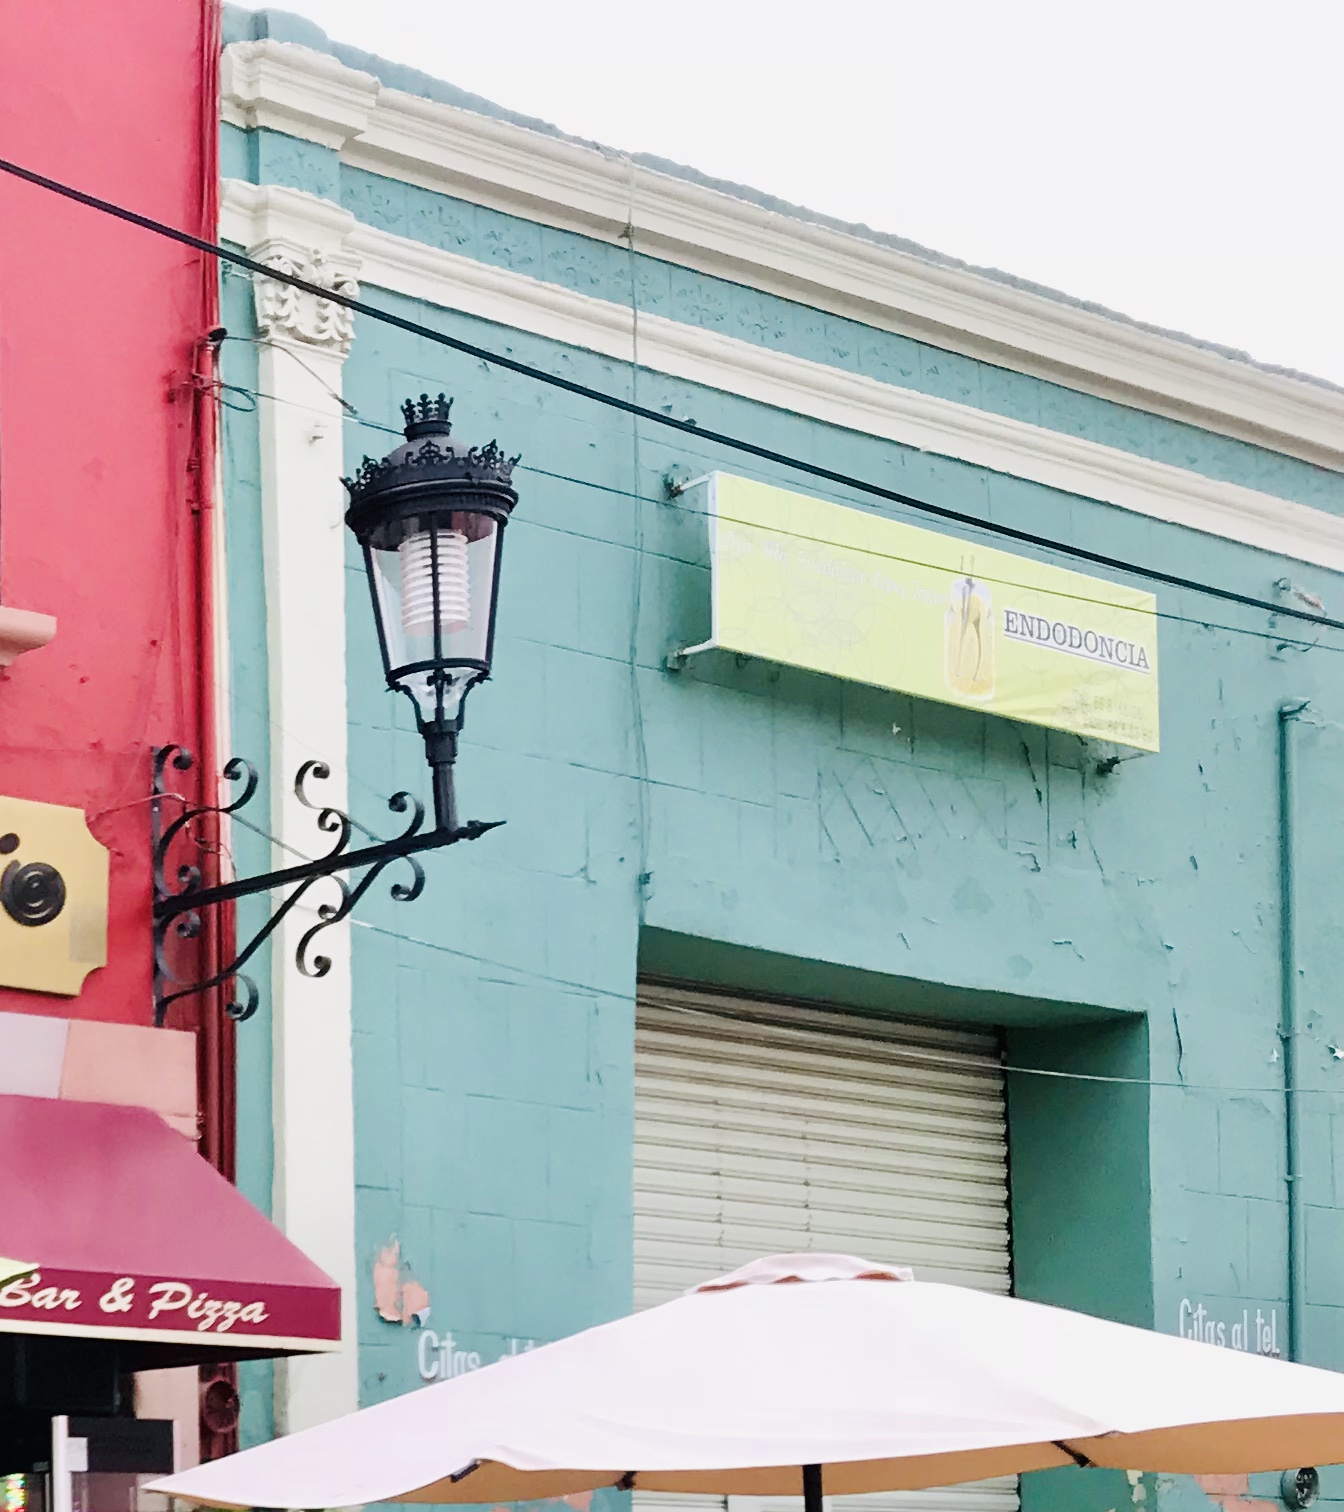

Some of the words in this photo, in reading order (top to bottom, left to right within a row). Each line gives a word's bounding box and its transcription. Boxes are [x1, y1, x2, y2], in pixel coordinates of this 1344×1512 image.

[1004, 609, 1150, 670] ENDODONCIA
[99, 1277, 134, 1313] &
[148, 1282, 271, 1332] Pizza
[1179, 1298, 1226, 1348] Citas
[1232, 1309, 1249, 1351] al
